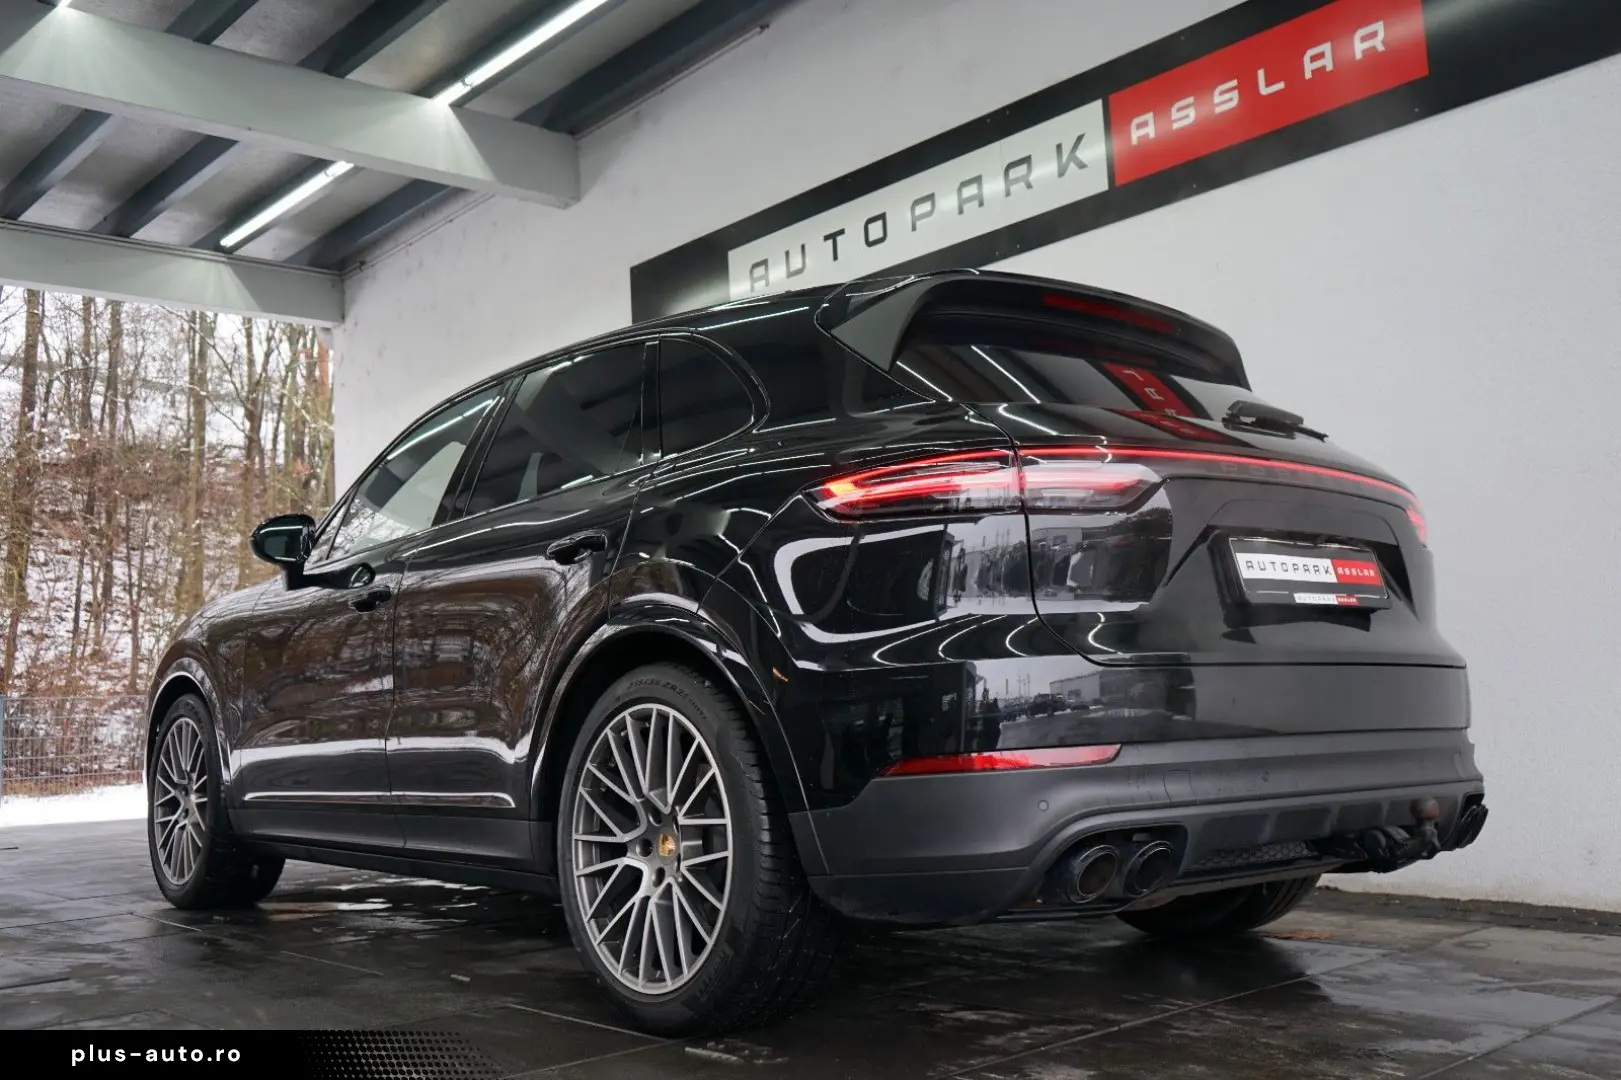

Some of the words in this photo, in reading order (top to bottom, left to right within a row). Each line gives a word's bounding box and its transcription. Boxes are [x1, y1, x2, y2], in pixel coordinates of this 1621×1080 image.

[748, 133, 1089, 292] AUTOPARK
[1130, 20, 1385, 146] ASSLAR
[1245, 560, 1332, 576] AUTOPARK
